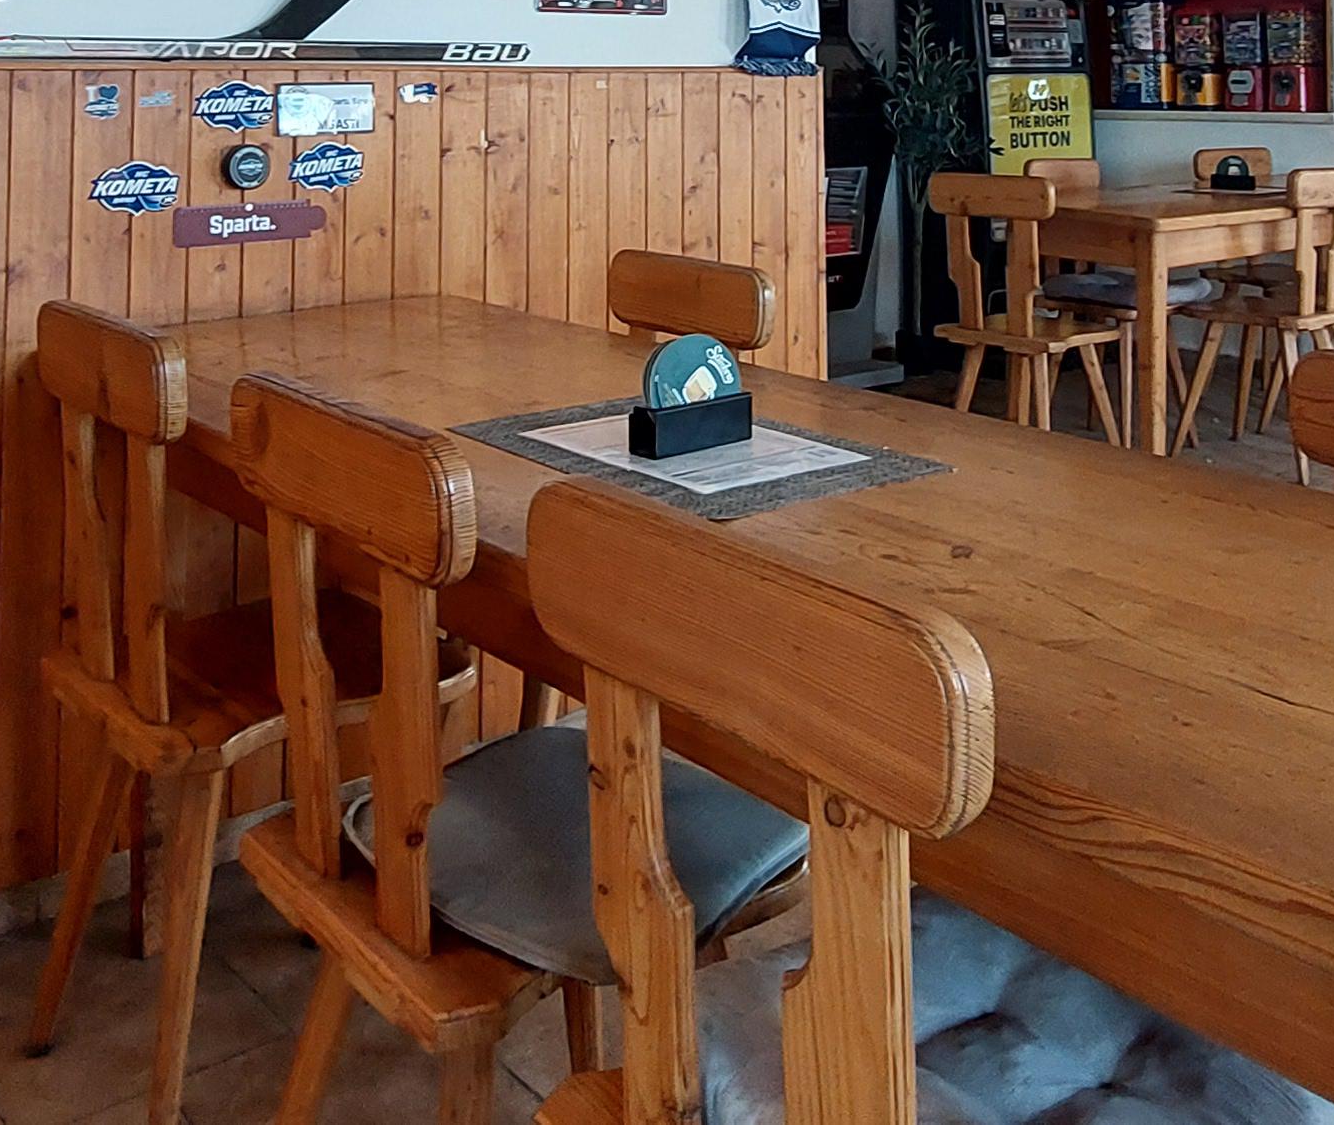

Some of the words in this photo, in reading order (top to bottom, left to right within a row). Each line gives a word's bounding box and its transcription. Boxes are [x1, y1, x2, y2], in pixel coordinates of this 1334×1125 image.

[195, 96, 274, 115] KOMETA
[1029, 95, 1069, 112] PUSH
[1009, 115, 1032, 129] THE
[1033, 114, 1071, 128] RIGHT
[1010, 131, 1071, 149] BUTTON
[291, 153, 364, 178] KOMETA
[92, 177, 179, 197] KOMETA
[209, 214, 277, 238] Sparta.
